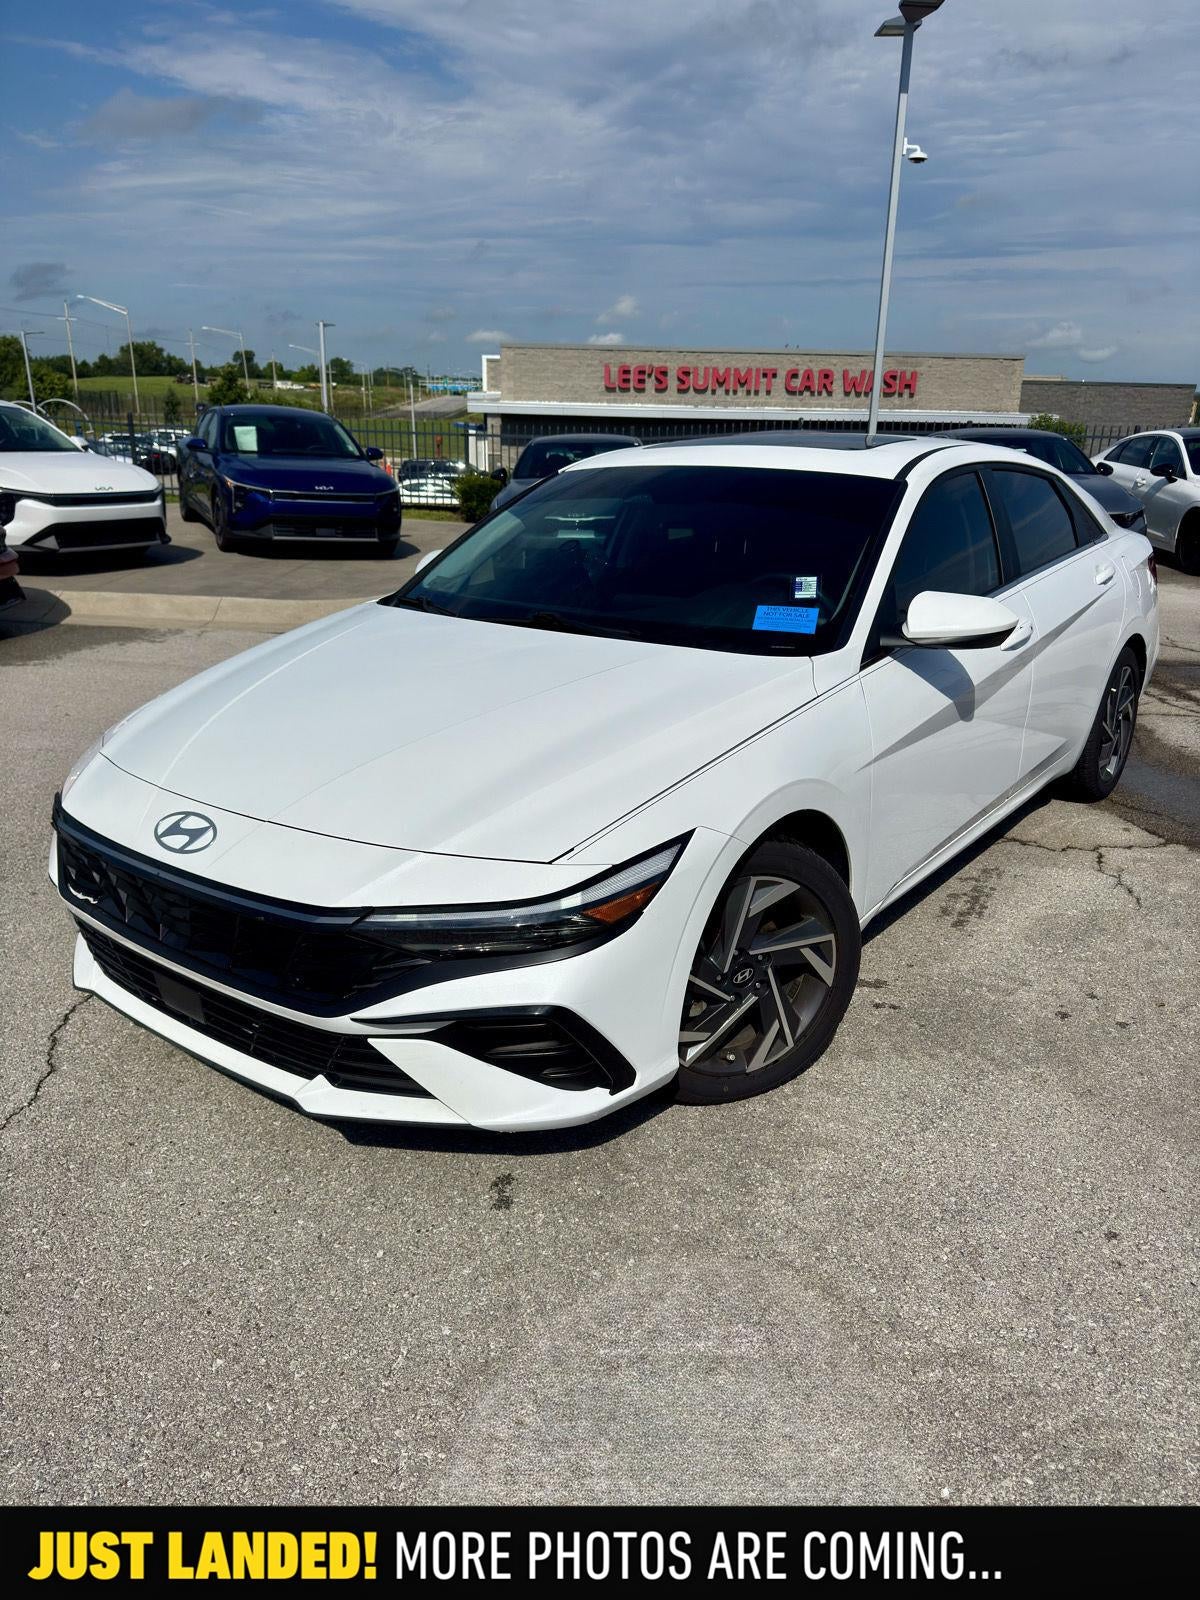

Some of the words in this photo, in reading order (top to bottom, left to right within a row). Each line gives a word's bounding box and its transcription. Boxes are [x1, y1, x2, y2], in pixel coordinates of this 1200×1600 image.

[603, 364, 669, 388] LEE'S
[676, 366, 777, 389] SUMMIT
[785, 368, 835, 390] CAR
